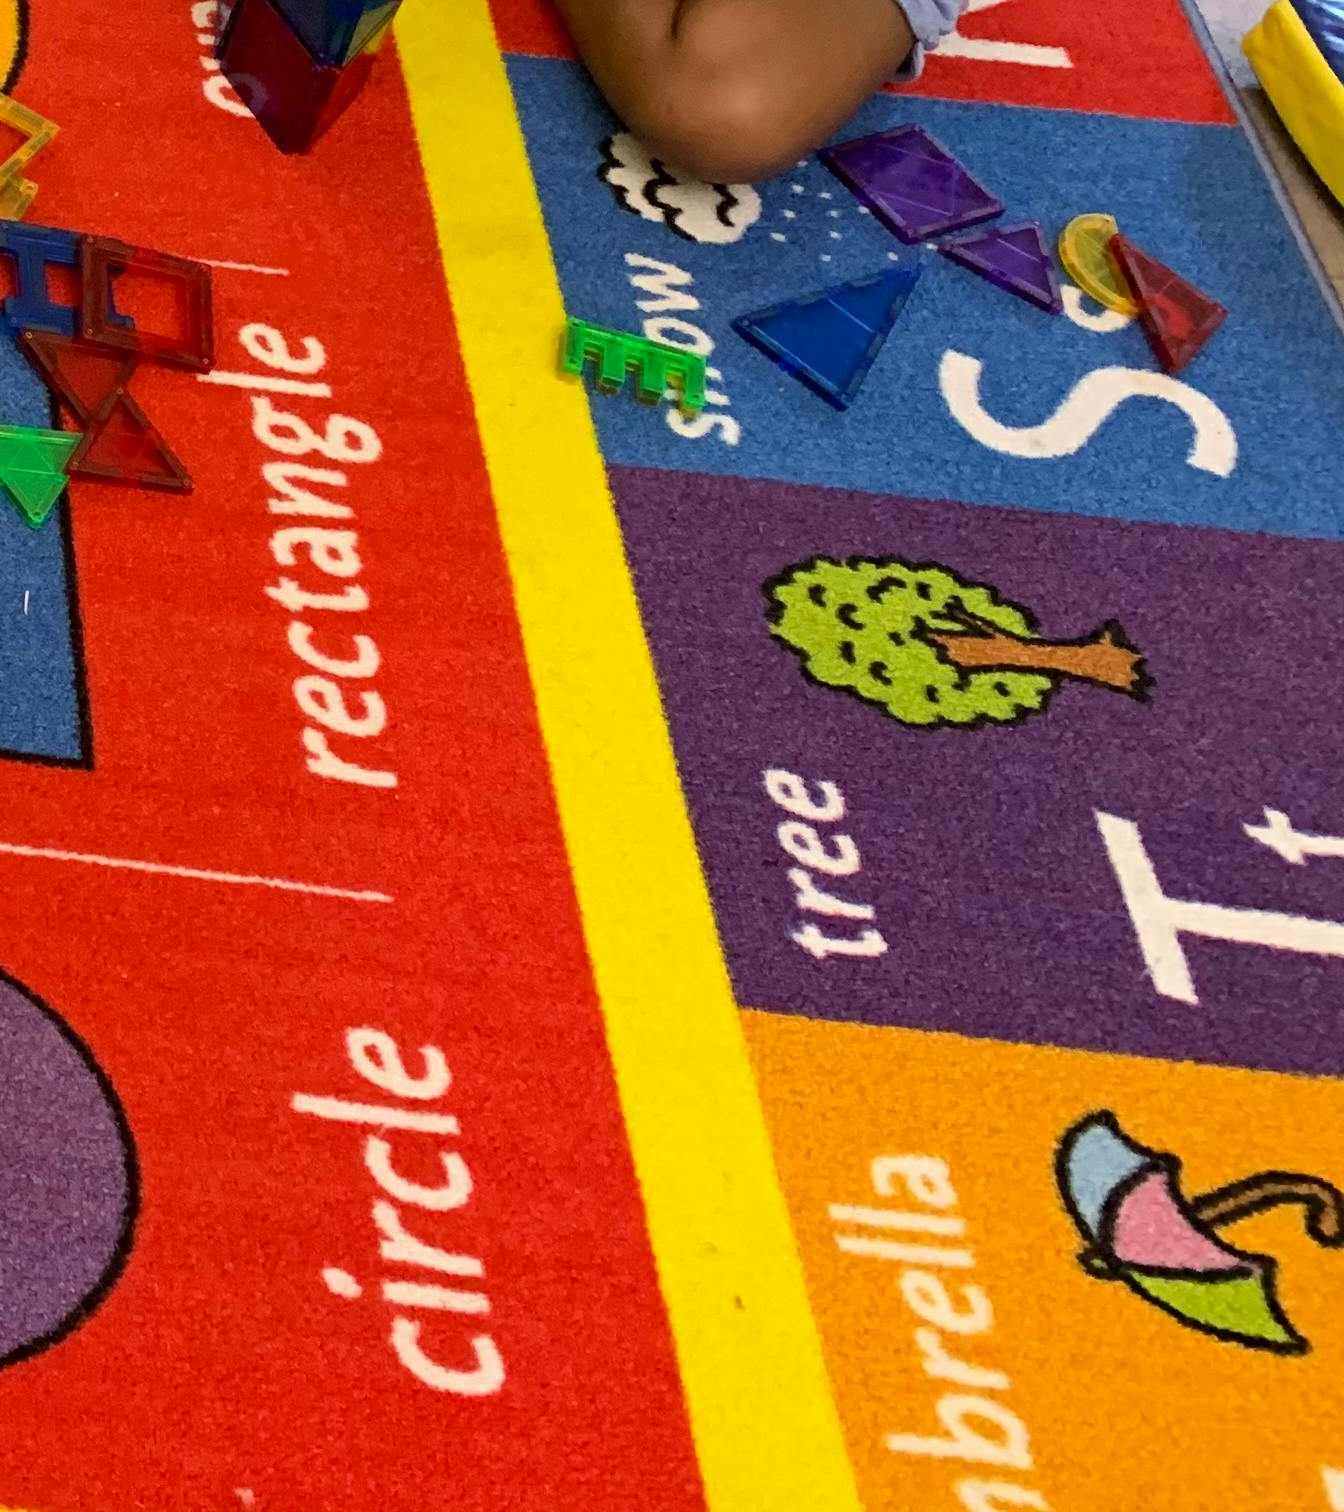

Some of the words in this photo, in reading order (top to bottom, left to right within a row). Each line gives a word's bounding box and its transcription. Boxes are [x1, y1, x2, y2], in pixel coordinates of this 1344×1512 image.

[624, 253, 742, 446] sow
[197, 323, 397, 787] rectangle
[762, 769, 887, 958] tree
[1095, 807, 1344, 1004] Tt
[291, 1026, 505, 1396] circle
